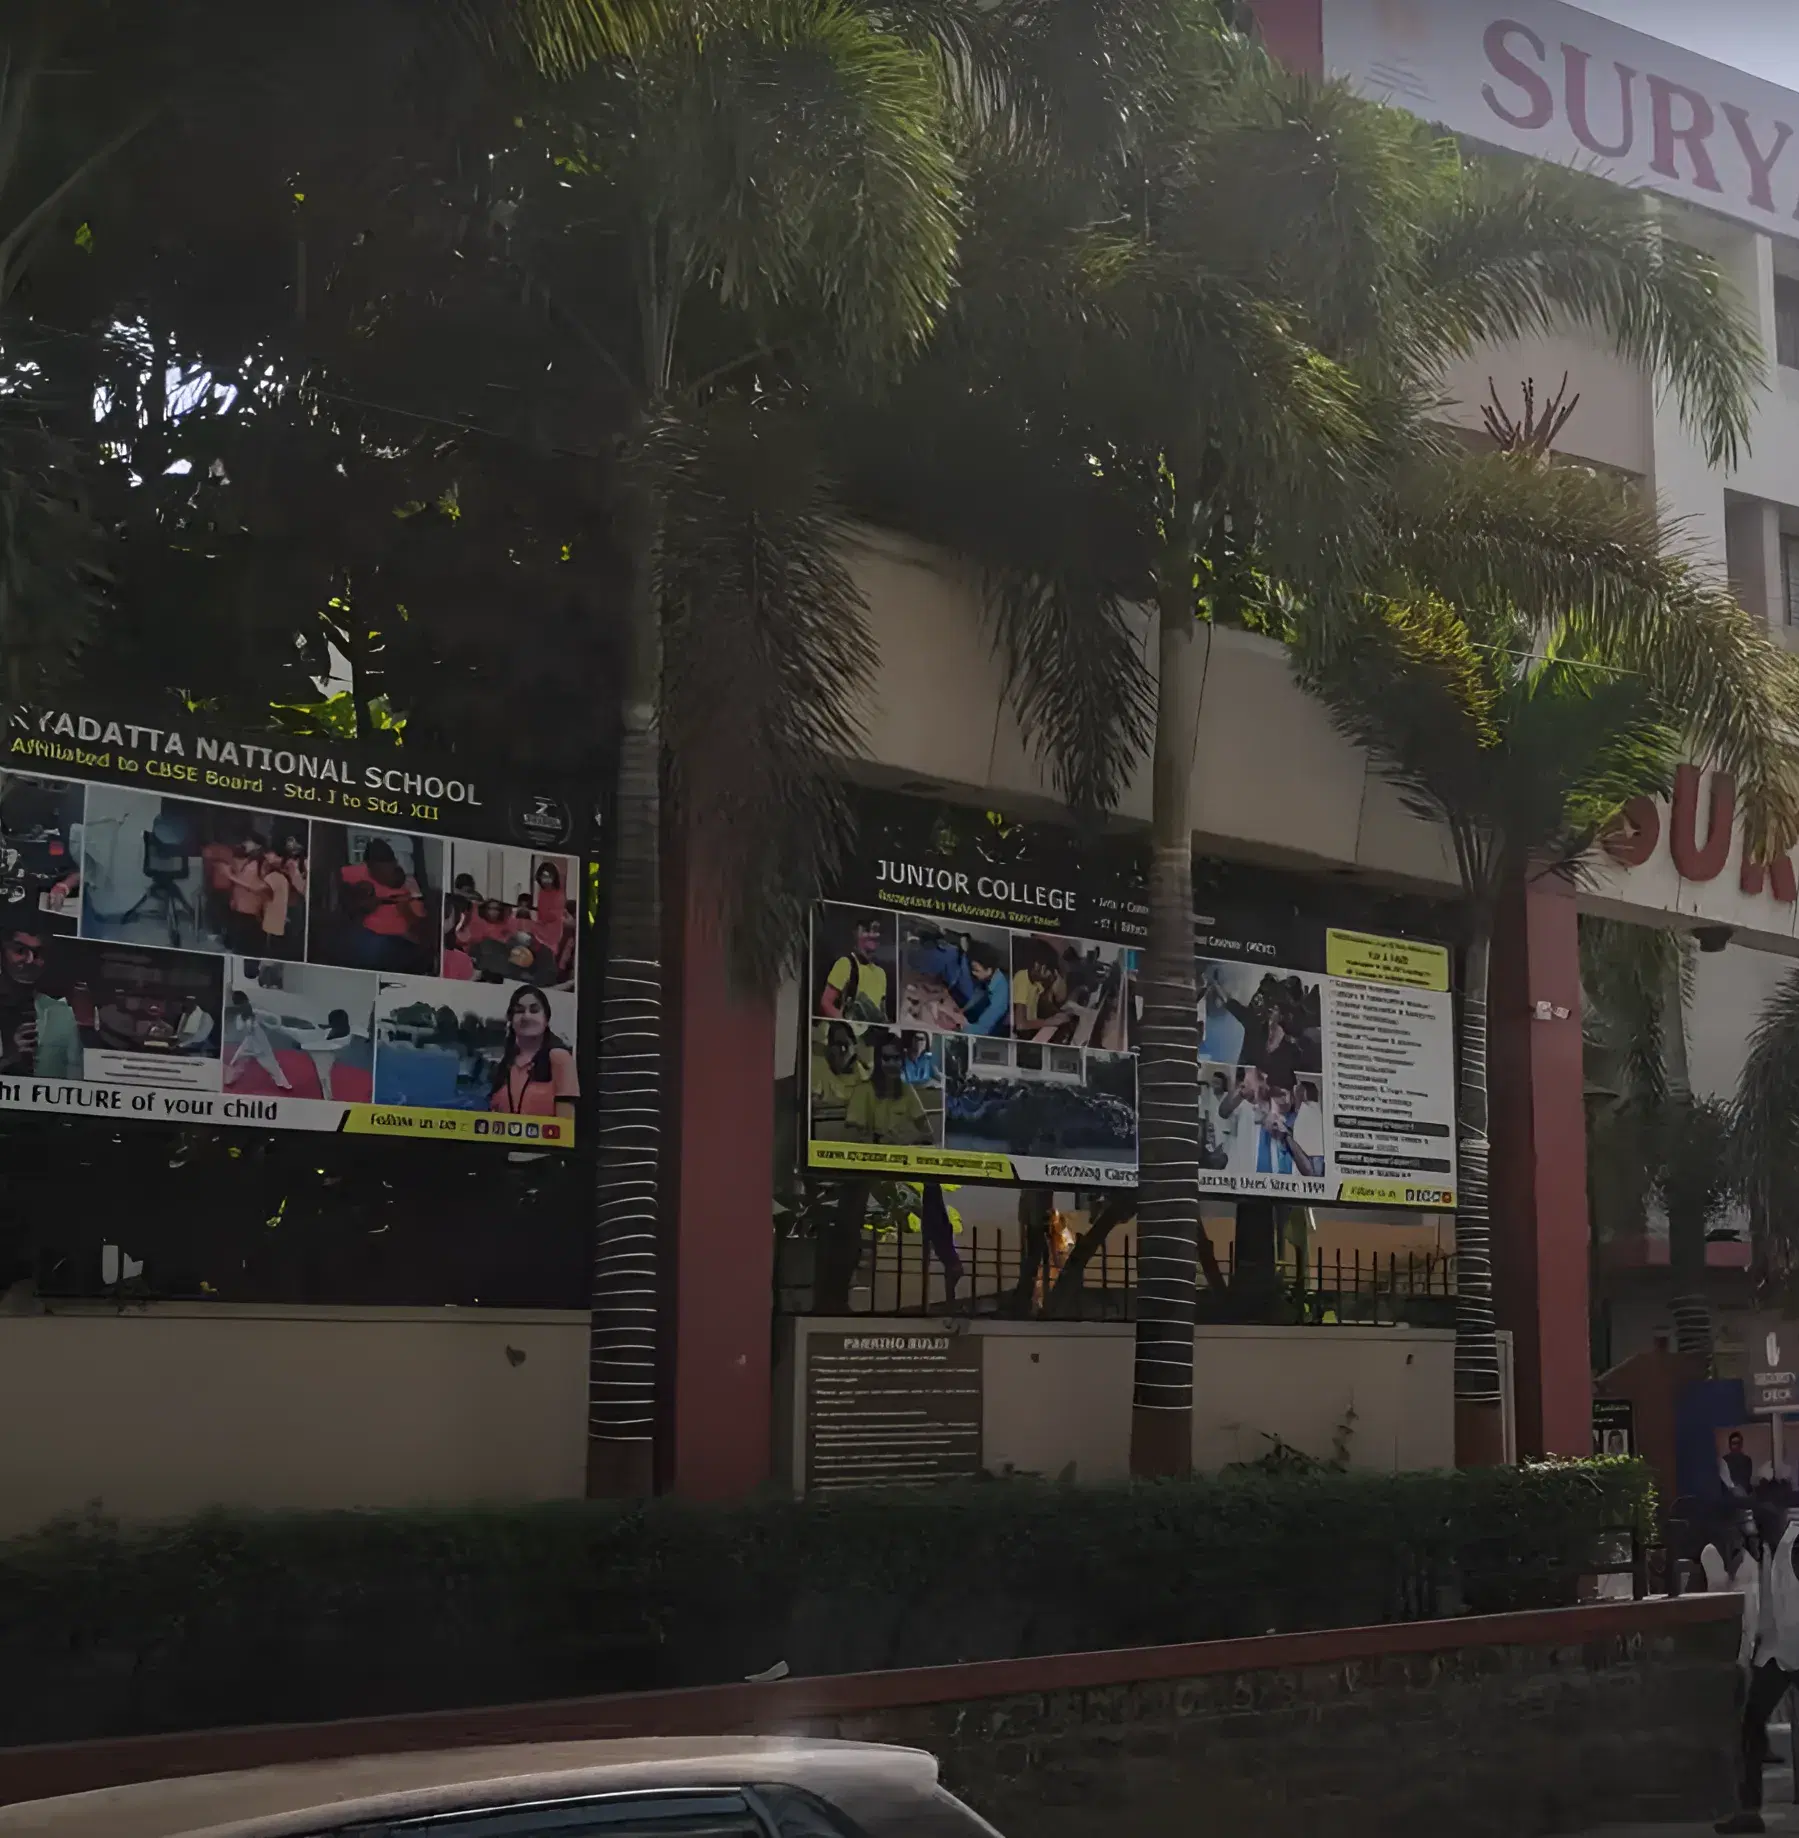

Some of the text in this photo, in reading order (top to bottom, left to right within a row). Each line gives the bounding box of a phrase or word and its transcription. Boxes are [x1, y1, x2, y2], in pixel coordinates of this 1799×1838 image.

[11, 737, 110, 768] Affiliated
[117, 756, 138, 773] to
[145, 760, 199, 783] CBSE
[205, 770, 262, 793] Board
[284, 783, 322, 802] Std.
[344, 793, 361, 808] to
[367, 797, 403, 816] Std.
[410, 804, 438, 821] XII
[196, 736, 356, 785] NATIONAL
[365, 766, 483, 806] SCHOOL
[876, 859, 1077, 912] JUNIOR COLLEGE
[32, 1084, 122, 1109] FUTURE
[132, 1092, 156, 1111] of
[164, 1097, 214, 1116] your
[223, 1098, 278, 1121] child
